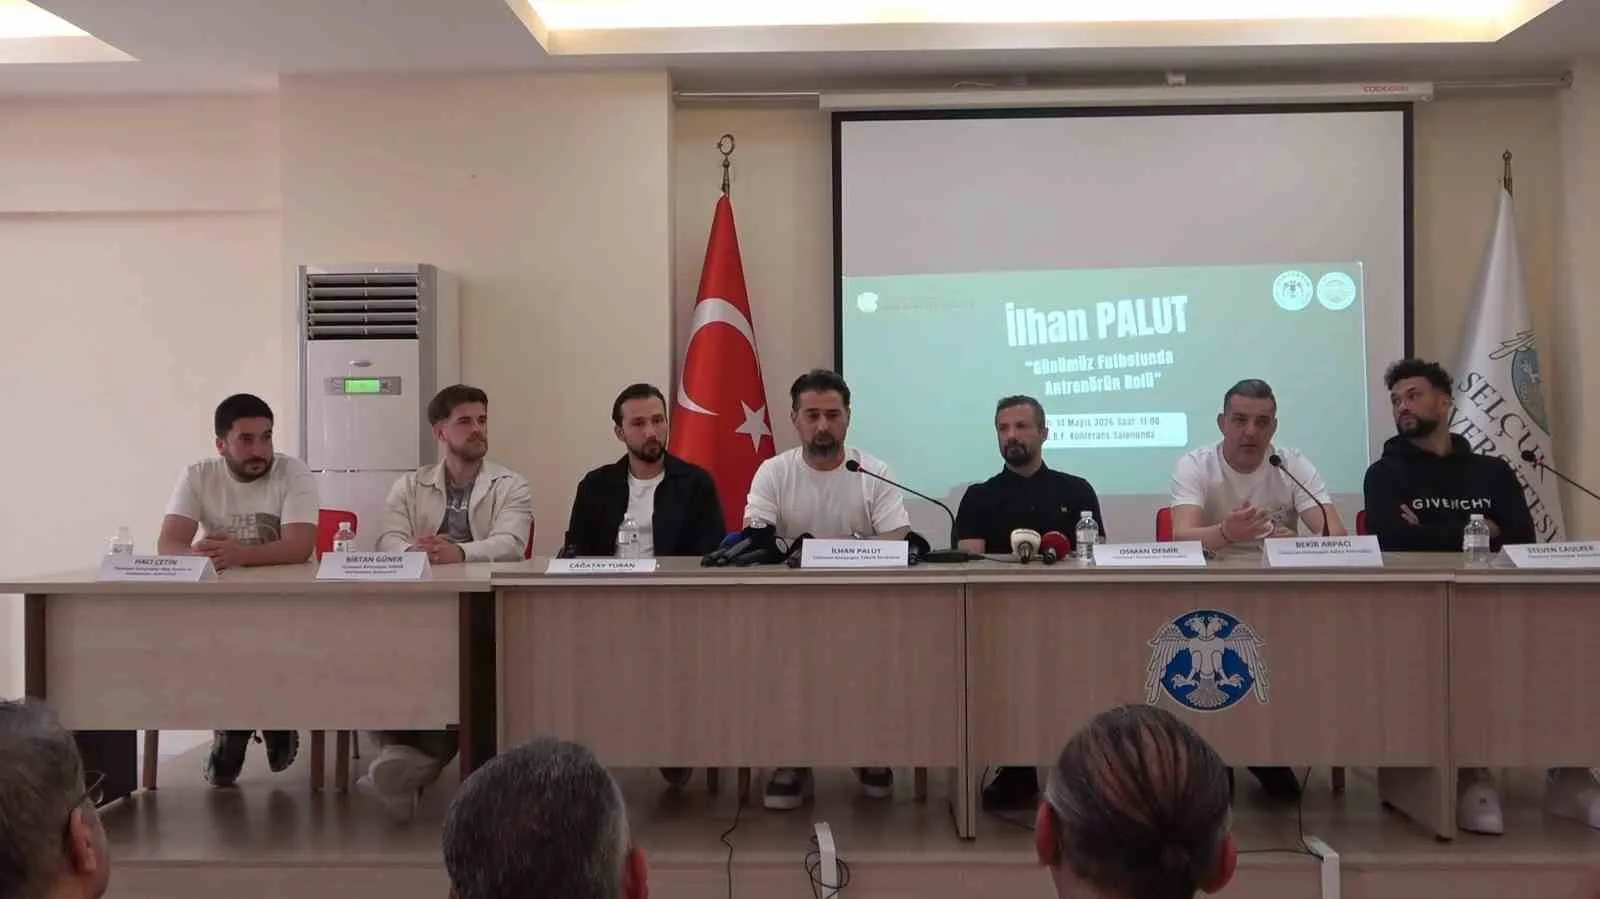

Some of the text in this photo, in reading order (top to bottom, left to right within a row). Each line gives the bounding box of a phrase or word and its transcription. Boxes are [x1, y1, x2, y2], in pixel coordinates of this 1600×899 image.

[1005, 295, 1188, 347] İlhan PALUT
[1412, 497, 1492, 510] GIVENCHY
